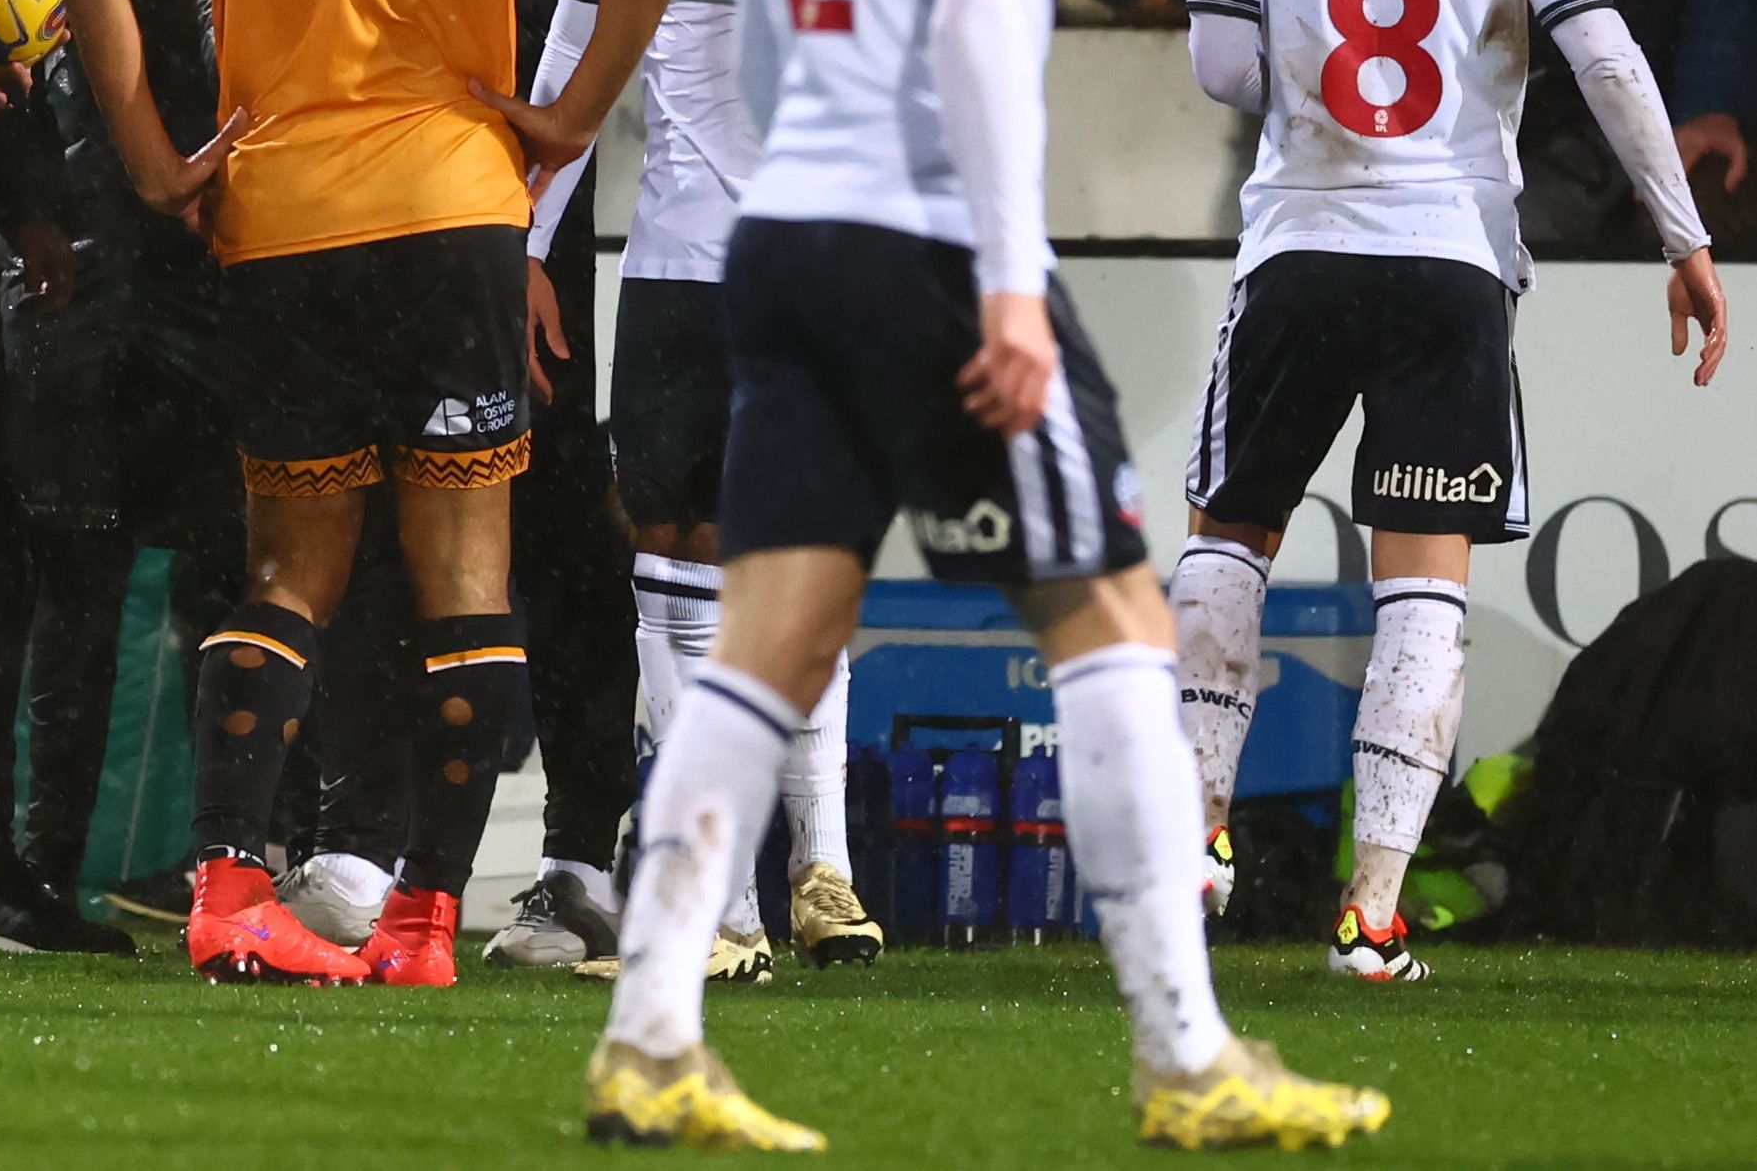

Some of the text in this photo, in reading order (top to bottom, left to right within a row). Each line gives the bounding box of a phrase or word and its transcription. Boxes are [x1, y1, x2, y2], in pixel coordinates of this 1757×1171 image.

[475, 390, 507, 408] ALAN
[476, 413, 515, 434] GROUP
[1373, 463, 1466, 502] utilita
[1180, 688, 1252, 720] BWFC
